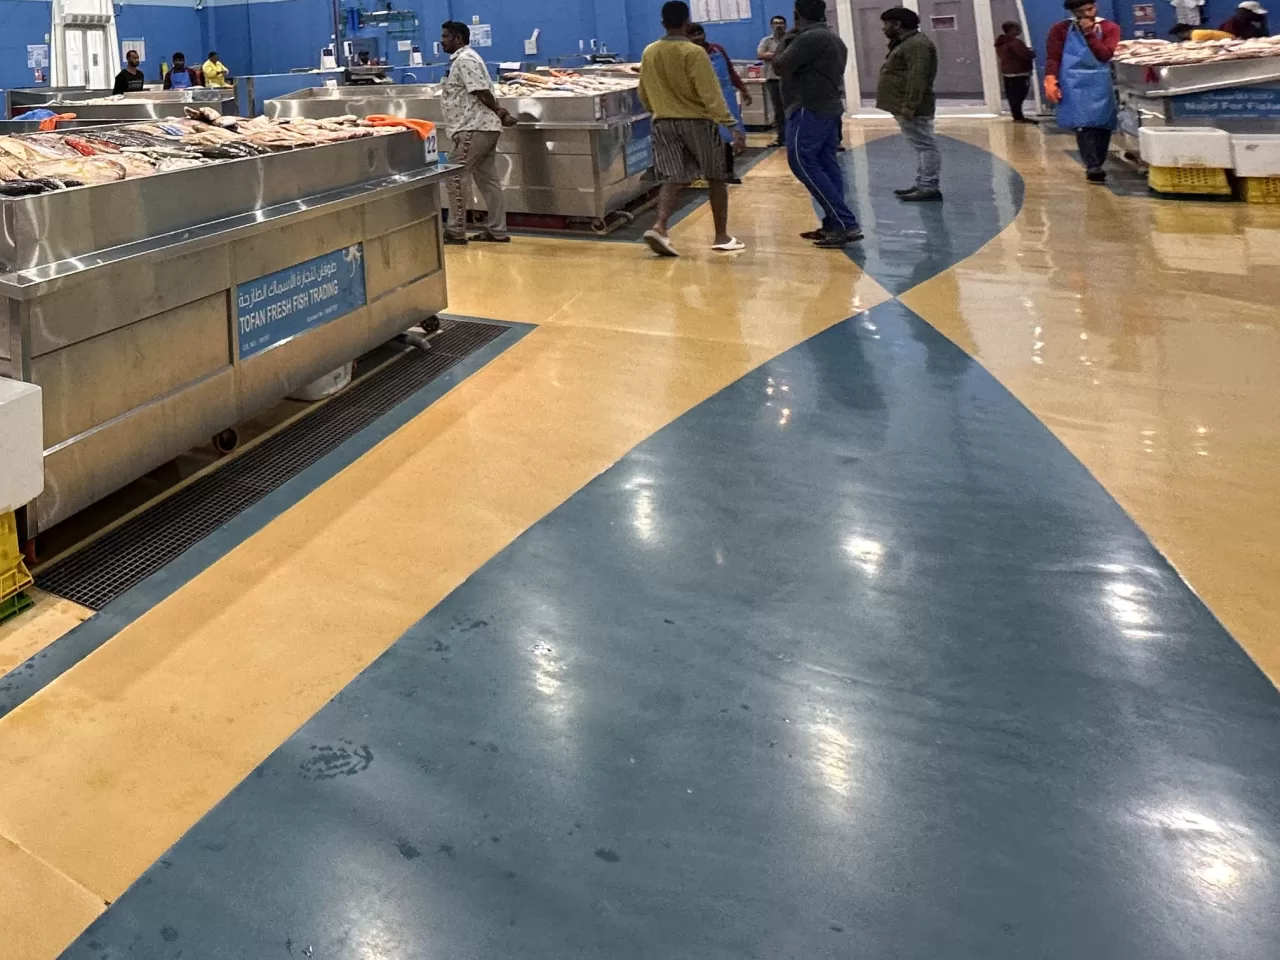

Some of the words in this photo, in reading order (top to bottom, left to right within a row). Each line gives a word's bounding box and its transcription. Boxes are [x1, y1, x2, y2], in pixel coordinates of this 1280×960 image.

[426, 135, 436, 154] 22
[239, 311, 266, 334] TOFAN
[267, 303, 292, 324] FRESH
[293, 292, 309, 312] FISH
[310, 280, 338, 303] TRADING
